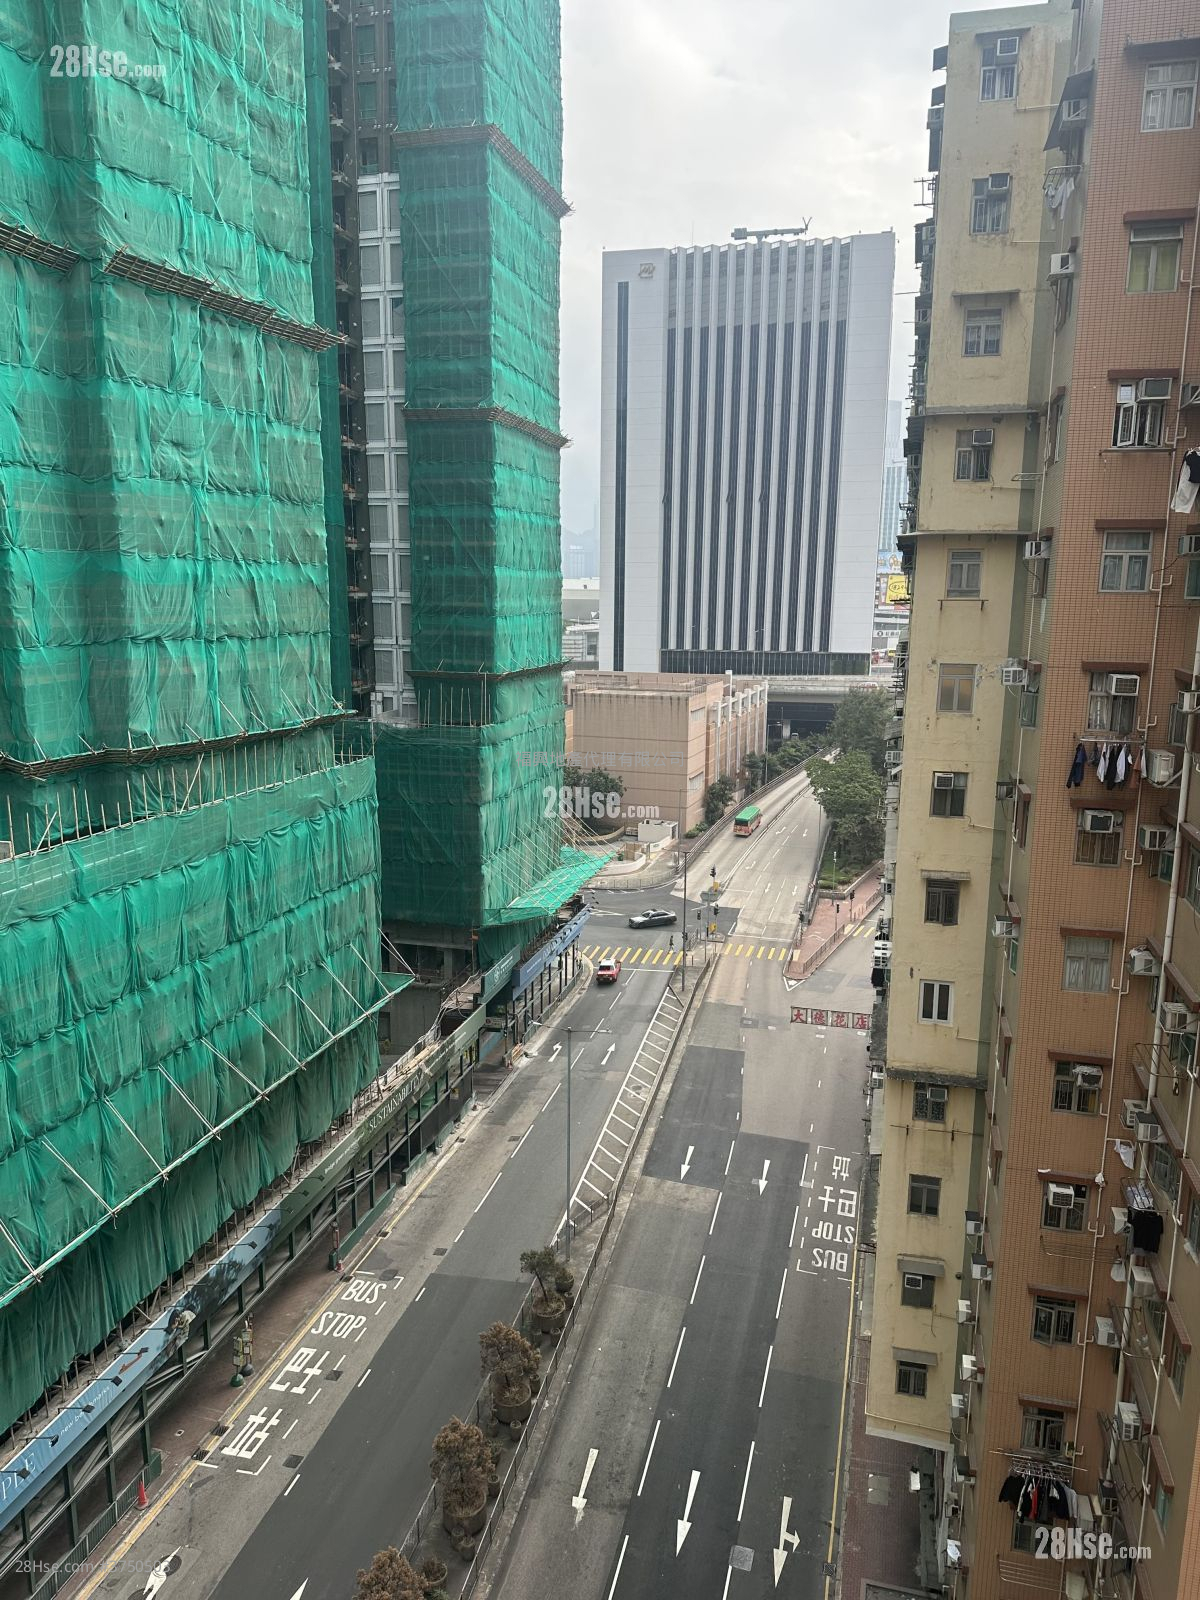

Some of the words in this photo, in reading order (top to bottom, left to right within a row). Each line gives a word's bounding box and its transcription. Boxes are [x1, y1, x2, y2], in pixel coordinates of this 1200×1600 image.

[792, 1009, 870, 1030] 大德花店
[832, 1155, 851, 1181] 站
[818, 1185, 857, 1218] 巴士
[811, 1220, 855, 1244] STOP
[811, 1247, 848, 1272] BUS
[341, 1279, 387, 1303] BUS
[311, 1311, 367, 1339] STOP
[268, 1347, 330, 1394] 巴士
[221, 1406, 283, 1459] 站
